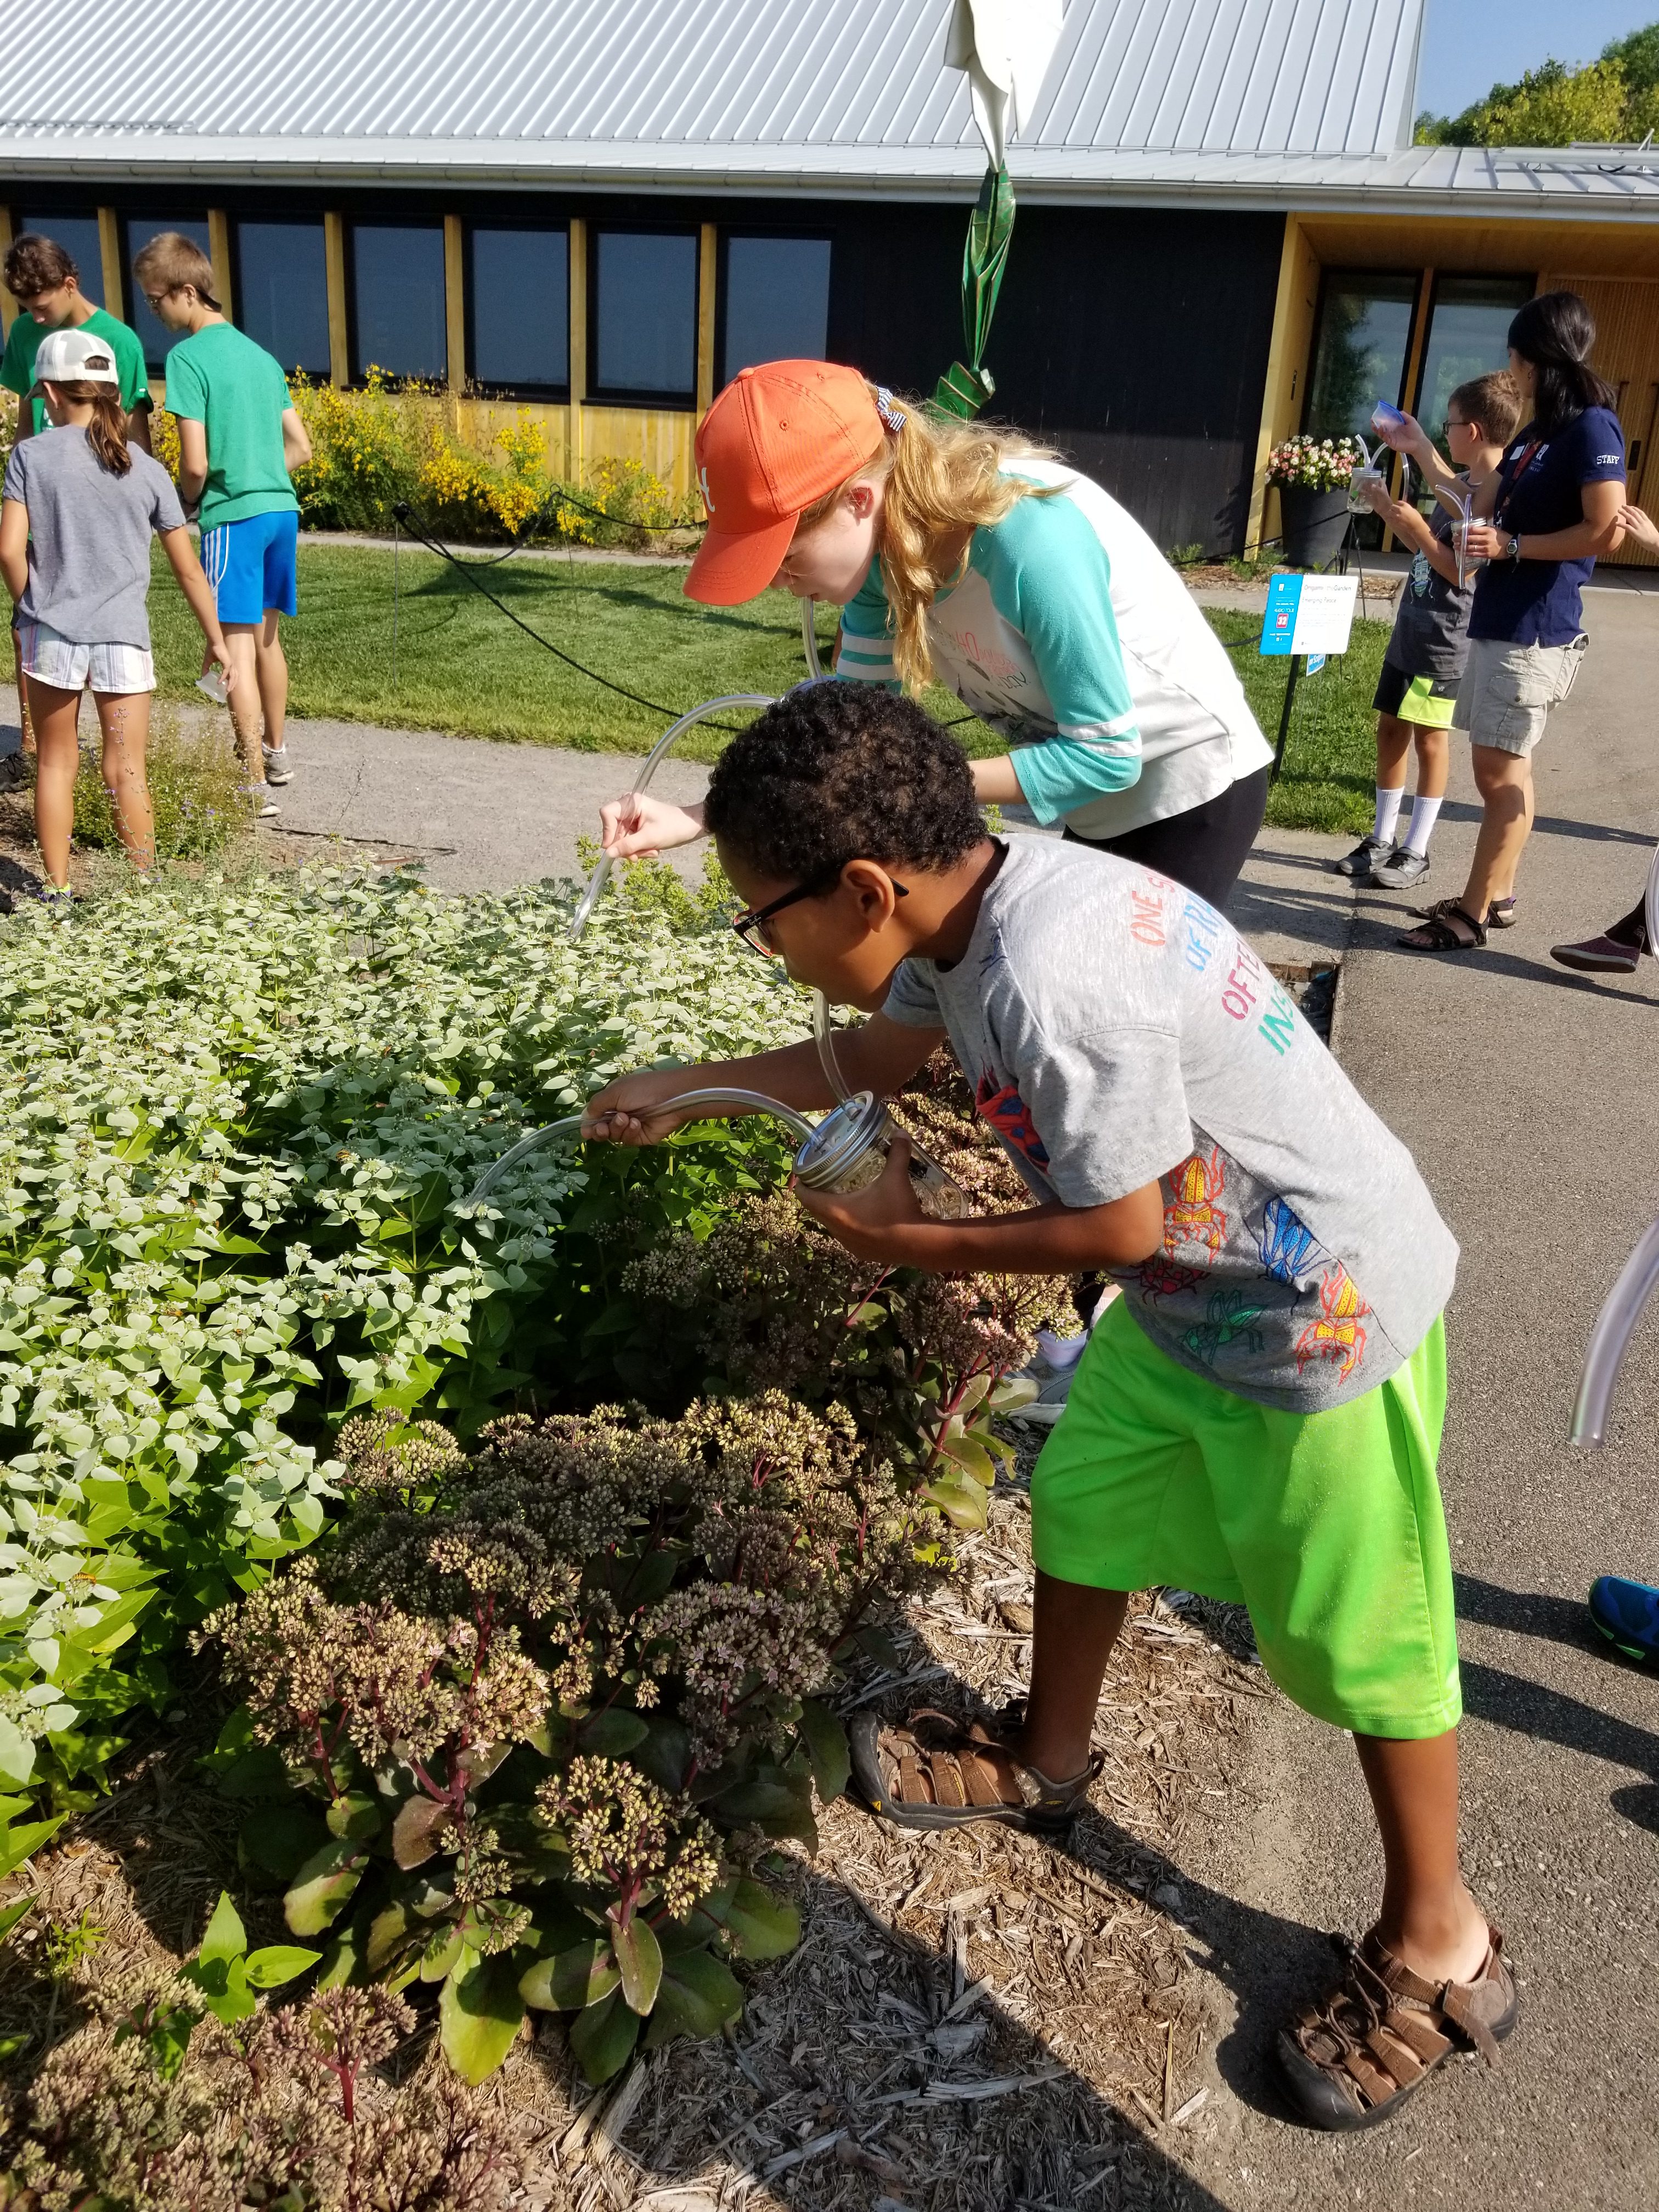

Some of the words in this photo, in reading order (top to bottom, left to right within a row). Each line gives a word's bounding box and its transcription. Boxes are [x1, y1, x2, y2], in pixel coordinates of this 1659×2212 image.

[1596, 455, 1620, 465] STAFF
[1277, 616, 1287, 625] 32
[1130, 890, 1166, 946] ONE
[1186, 924, 1212, 971] OF
